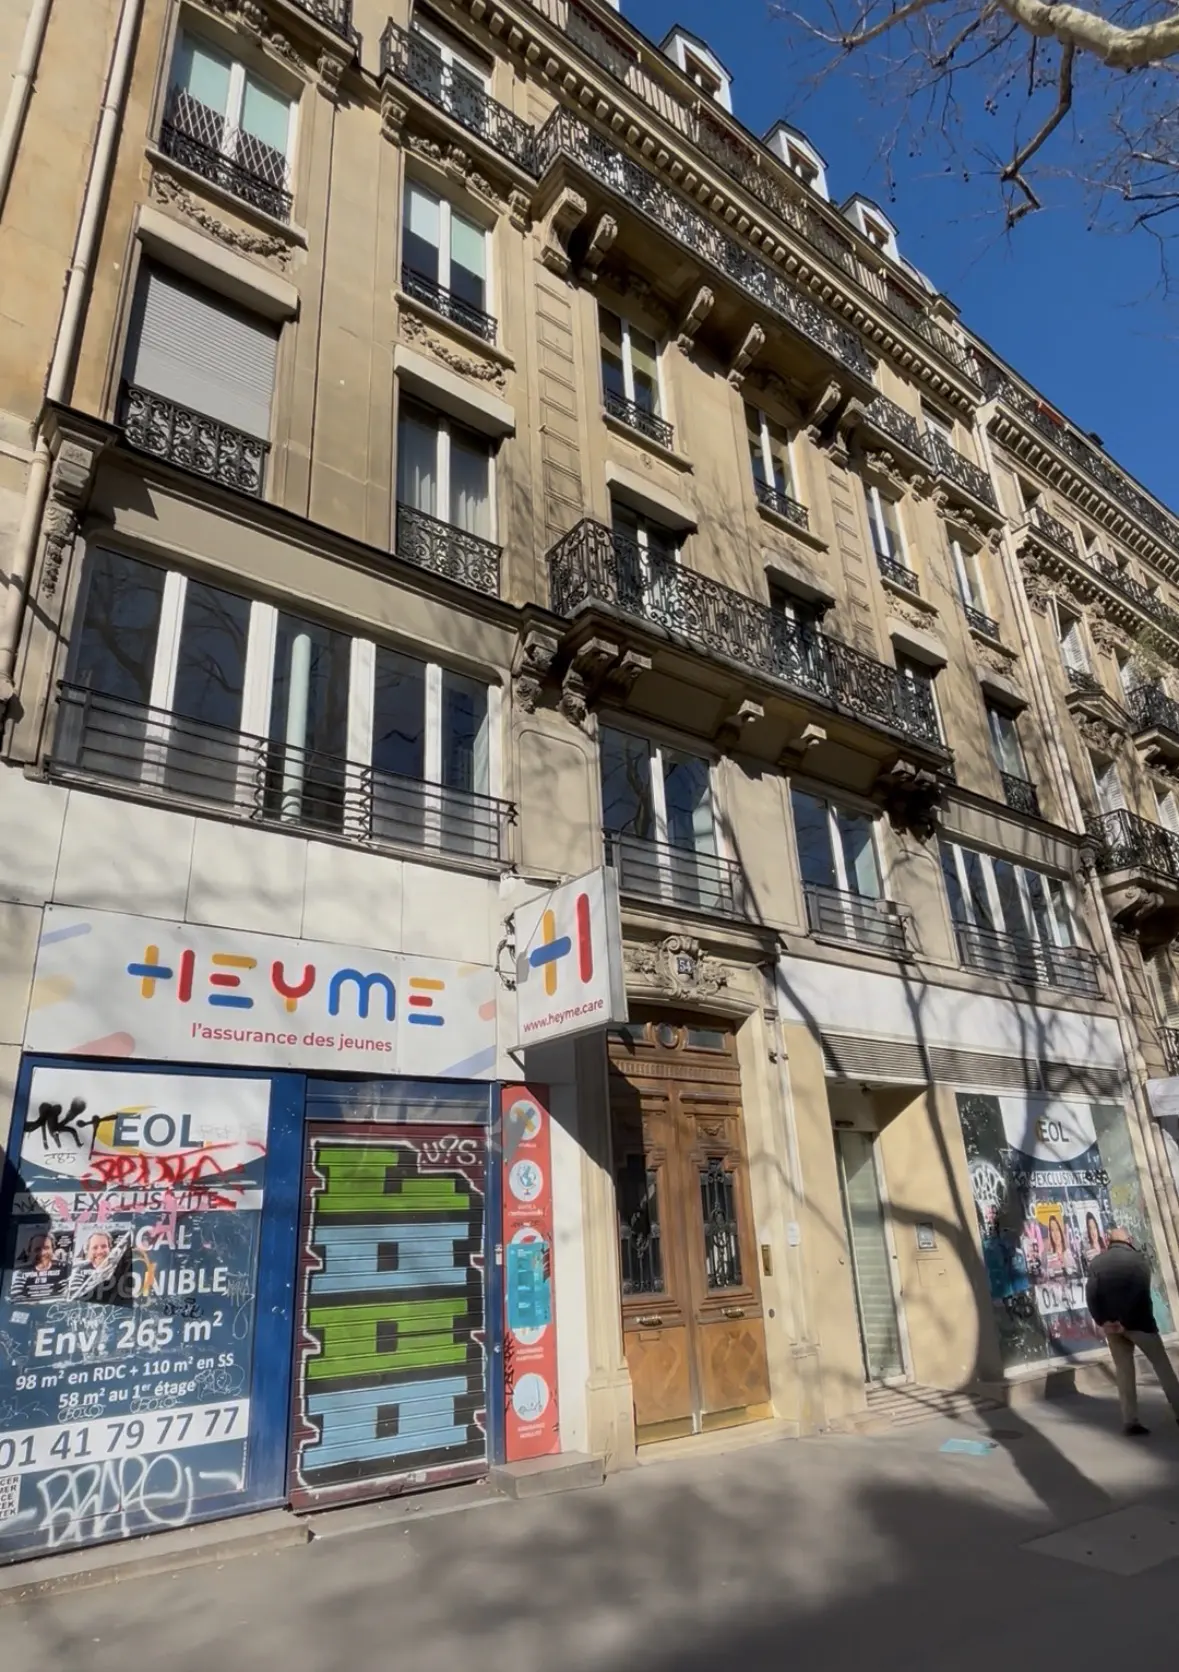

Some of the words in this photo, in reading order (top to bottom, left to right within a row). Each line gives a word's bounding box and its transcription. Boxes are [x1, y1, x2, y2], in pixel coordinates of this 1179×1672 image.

[679, 959, 692, 973] 54
[127, 944, 446, 1026] HEYME
[523, 998, 604, 1033] www.heyme.care
[191, 1022, 298, 1045] l'assurance
[303, 1031, 335, 1048] des
[337, 1033, 392, 1053] jeunes
[1036, 1120, 1069, 1142] EOL
[35, 1327, 106, 1357] Env.
[117, 1317, 173, 1349] 265
[184, 1311, 223, 1342] m²
[15, 1374, 37, 1391] 98
[41, 1369, 64, 1388] m²
[68, 1371, 88, 1385] en
[93, 1364, 126, 1382] RDC
[142, 1360, 170, 1376] 110
[173, 1356, 193, 1373] m²
[196, 1357, 214, 1370] en
[218, 1353, 234, 1368] SS
[58, 1391, 79, 1409] 58
[83, 1387, 105, 1406] m²
[108, 1388, 128, 1402] au
[132, 1383, 151, 1400] 1er
[154, 1380, 196, 1397] étage
[0, 1435, 36, 1470] 01
[50, 1426, 92, 1460] 41
[107, 1419, 145, 1453] 79
[157, 1412, 193, 1445] 77
[204, 1406, 240, 1438] 77
